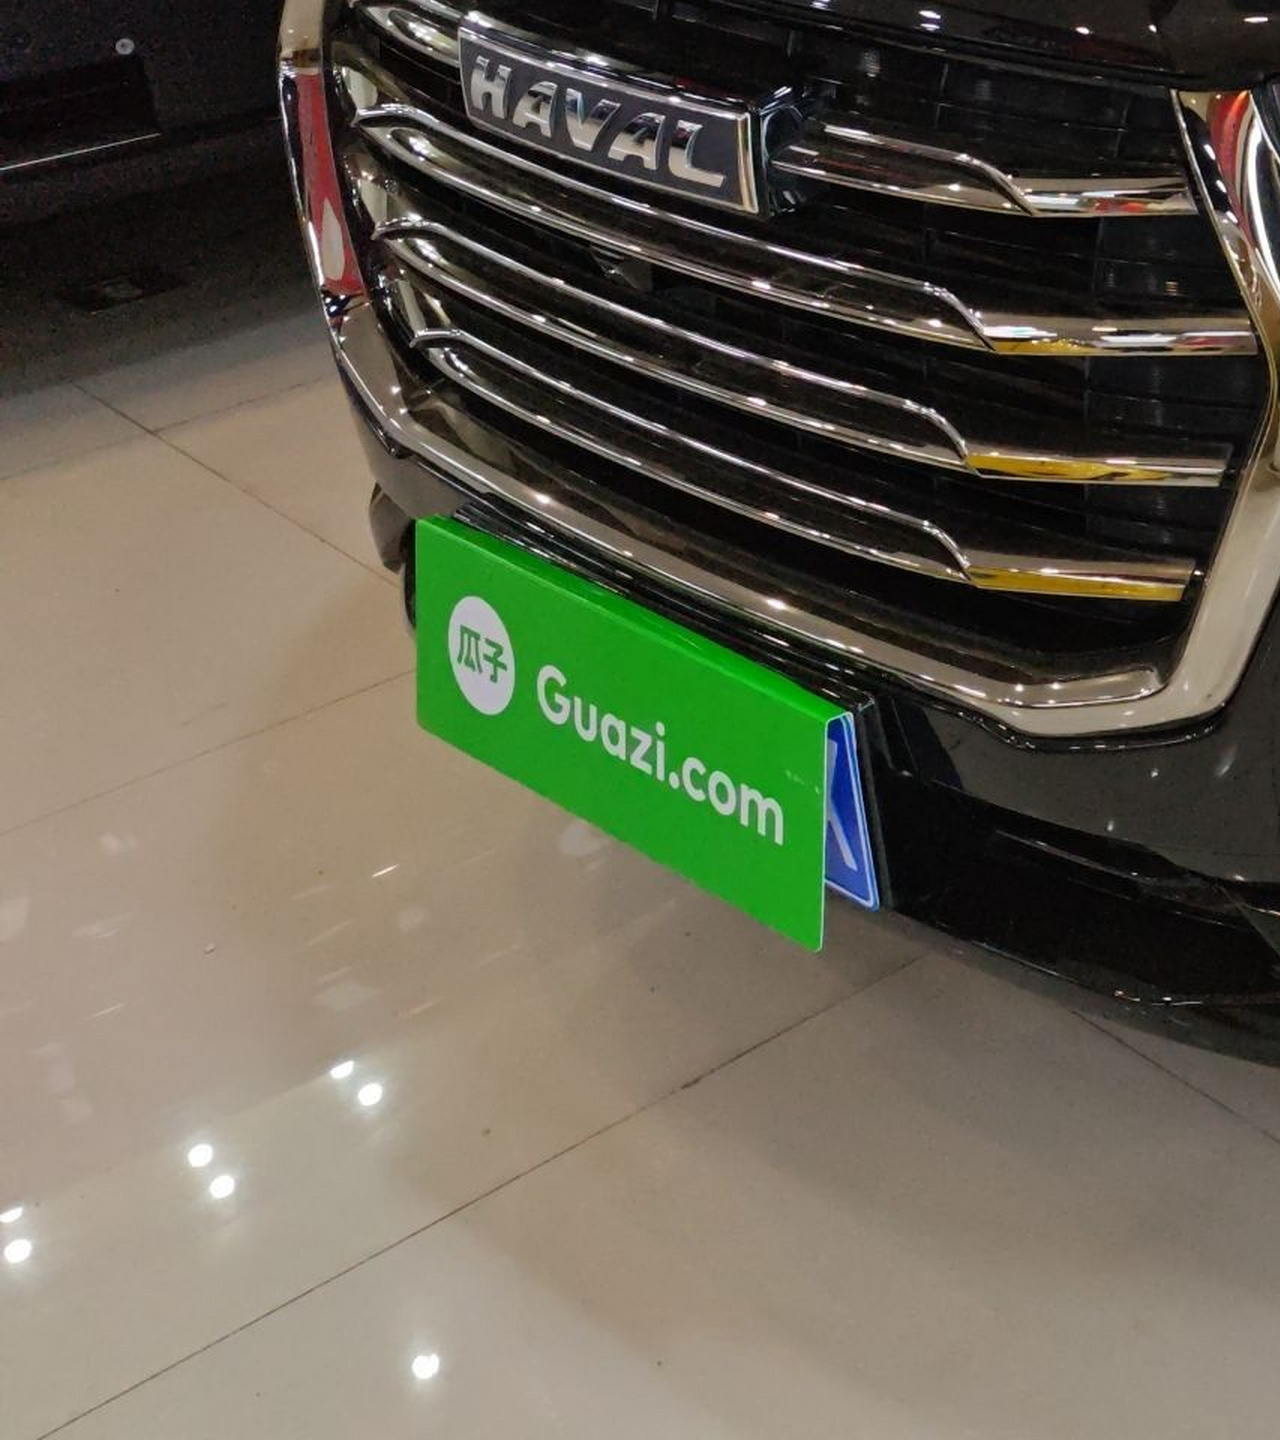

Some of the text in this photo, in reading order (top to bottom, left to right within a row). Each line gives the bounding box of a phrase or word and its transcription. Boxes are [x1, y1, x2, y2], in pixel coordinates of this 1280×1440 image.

[470, 55, 727, 188] HAVAL
[457, 623, 508, 685] 瓜子
[536, 664, 785, 847] Guazi.com
